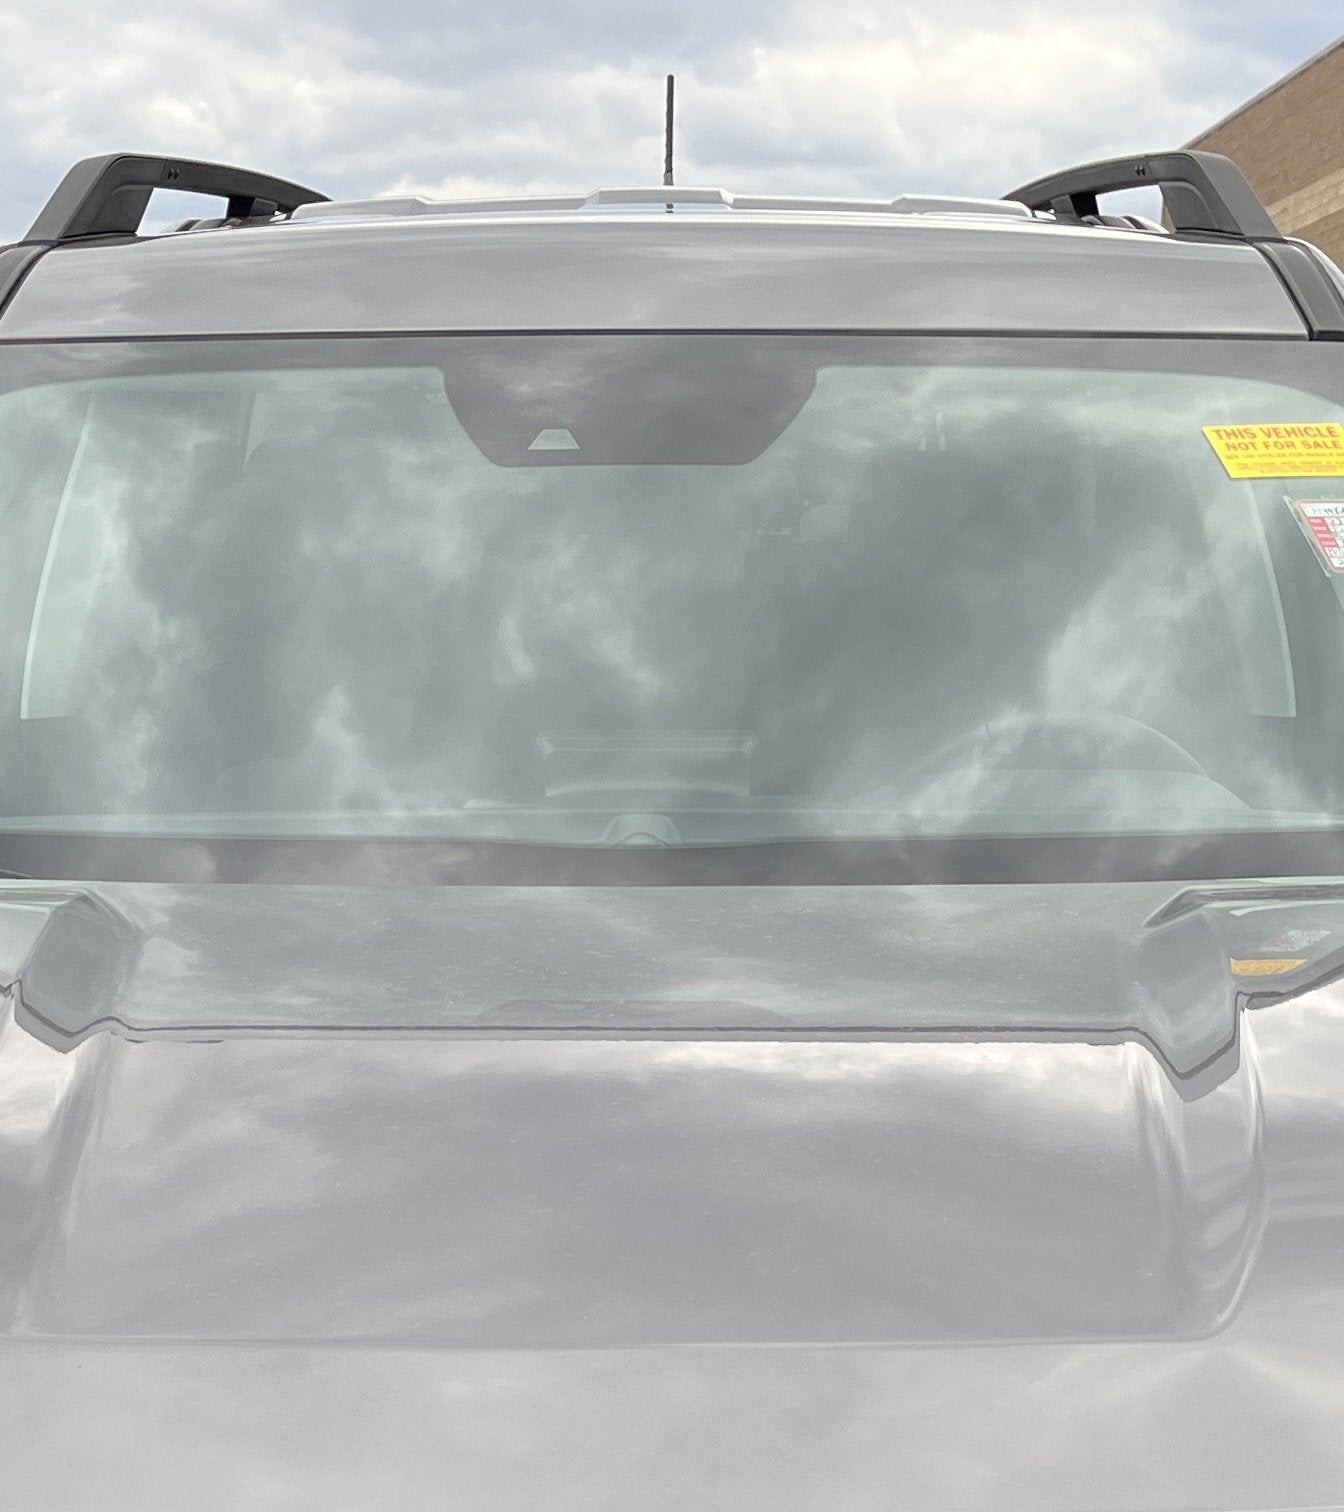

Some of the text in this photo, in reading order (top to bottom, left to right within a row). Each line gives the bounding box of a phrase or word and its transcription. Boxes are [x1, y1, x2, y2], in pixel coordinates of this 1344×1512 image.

[1212, 426, 1341, 440] THIS VEHICLE
[1224, 440, 1344, 452] NOT FOR SALE
